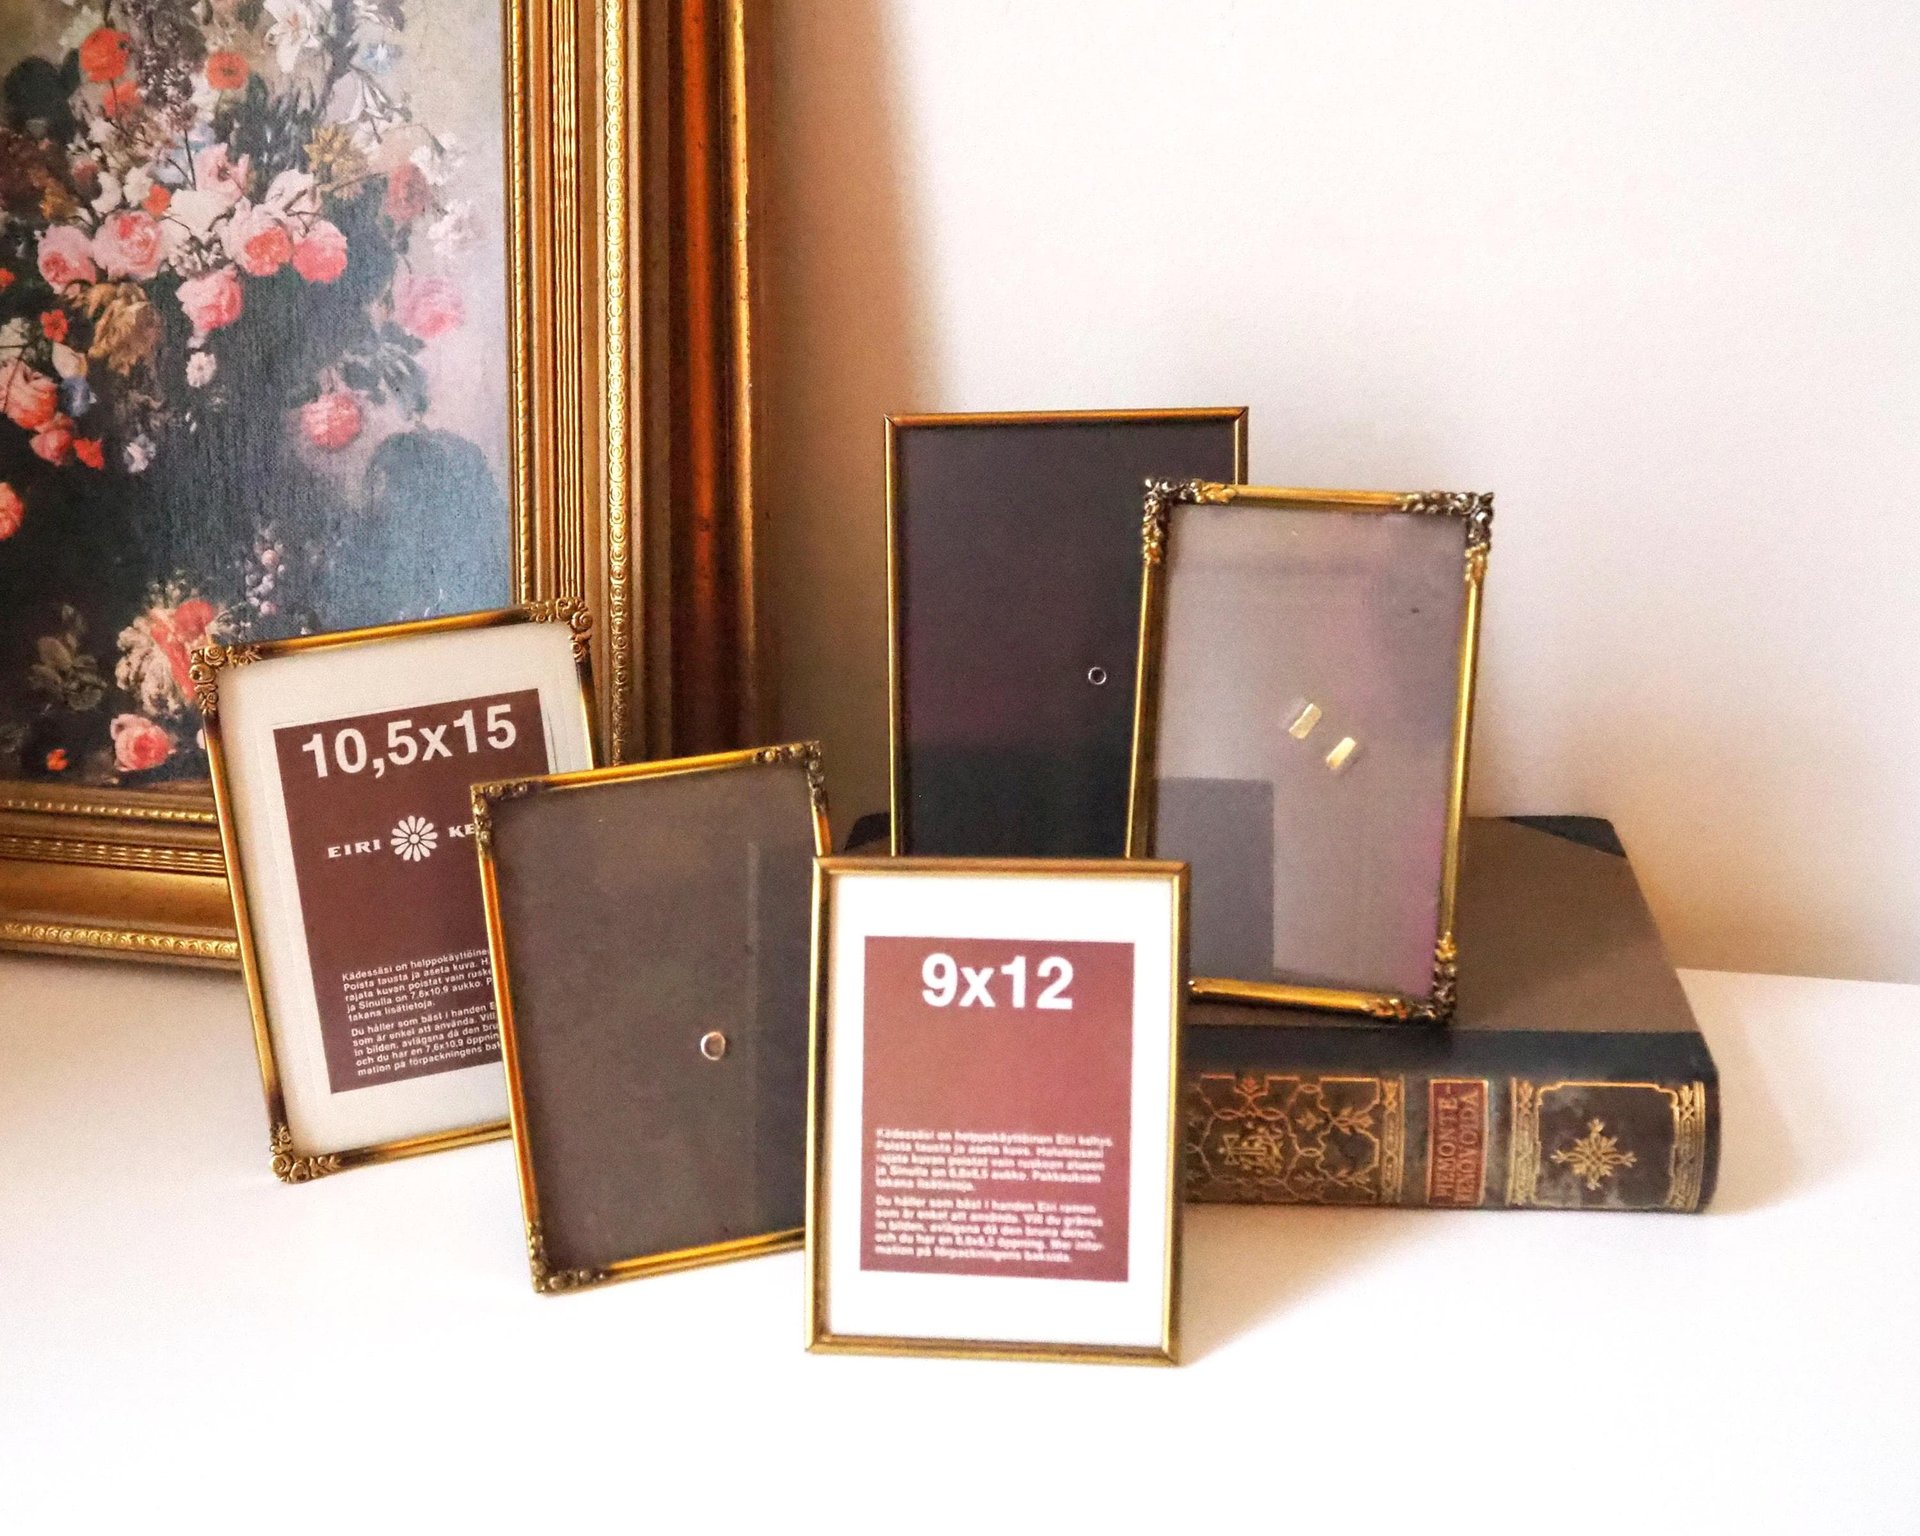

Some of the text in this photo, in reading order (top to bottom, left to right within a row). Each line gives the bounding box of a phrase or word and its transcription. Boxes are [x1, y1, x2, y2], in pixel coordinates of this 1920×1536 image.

[302, 703, 517, 779] 10,5x15
[327, 839, 381, 859] EIRI
[342, 948, 489, 981] Kädessäsi on helppokäyttöine
[343, 979, 374, 991] Poista
[377, 973, 408, 985] tausta
[411, 971, 420, 980] ja
[423, 965, 449, 977] aseta
[344, 990, 373, 1001] rajata
[376, 984, 405, 995] kuvan
[407, 976, 442, 991] poistat
[444, 973, 464, 982] vain
[922, 952, 1074, 1010] 9x12
[346, 1004, 355, 1013] ja
[357, 997, 392, 1009] Sinulla
[395, 994, 407, 1002] on
[348, 999, 435, 1021] takana lisätietoja.
[351, 1028, 364, 1036] Du
[367, 1022, 394, 1033] håller
[397, 1018, 418, 1028] som
[420, 1012, 442, 1023] bäst
[450, 1005, 486, 1017] handen
[352, 1037, 373, 1046] som
[389, 1027, 414, 1039] enkel
[417, 1024, 431, 1033] att
[353, 1048, 363, 1056] in
[402, 1033, 444, 1047] avlägsna
[447, 1029, 459, 1038] då
[462, 1026, 479, 1035] den
[355, 1056, 374, 1066] och
[376, 1053, 388, 1062] du
[391, 1050, 407, 1058] har
[410, 1047, 422, 1055] en
[357, 1064, 390, 1075] mation
[394, 1060, 405, 1070] på
[409, 1044, 482, 1065] förpackningens
